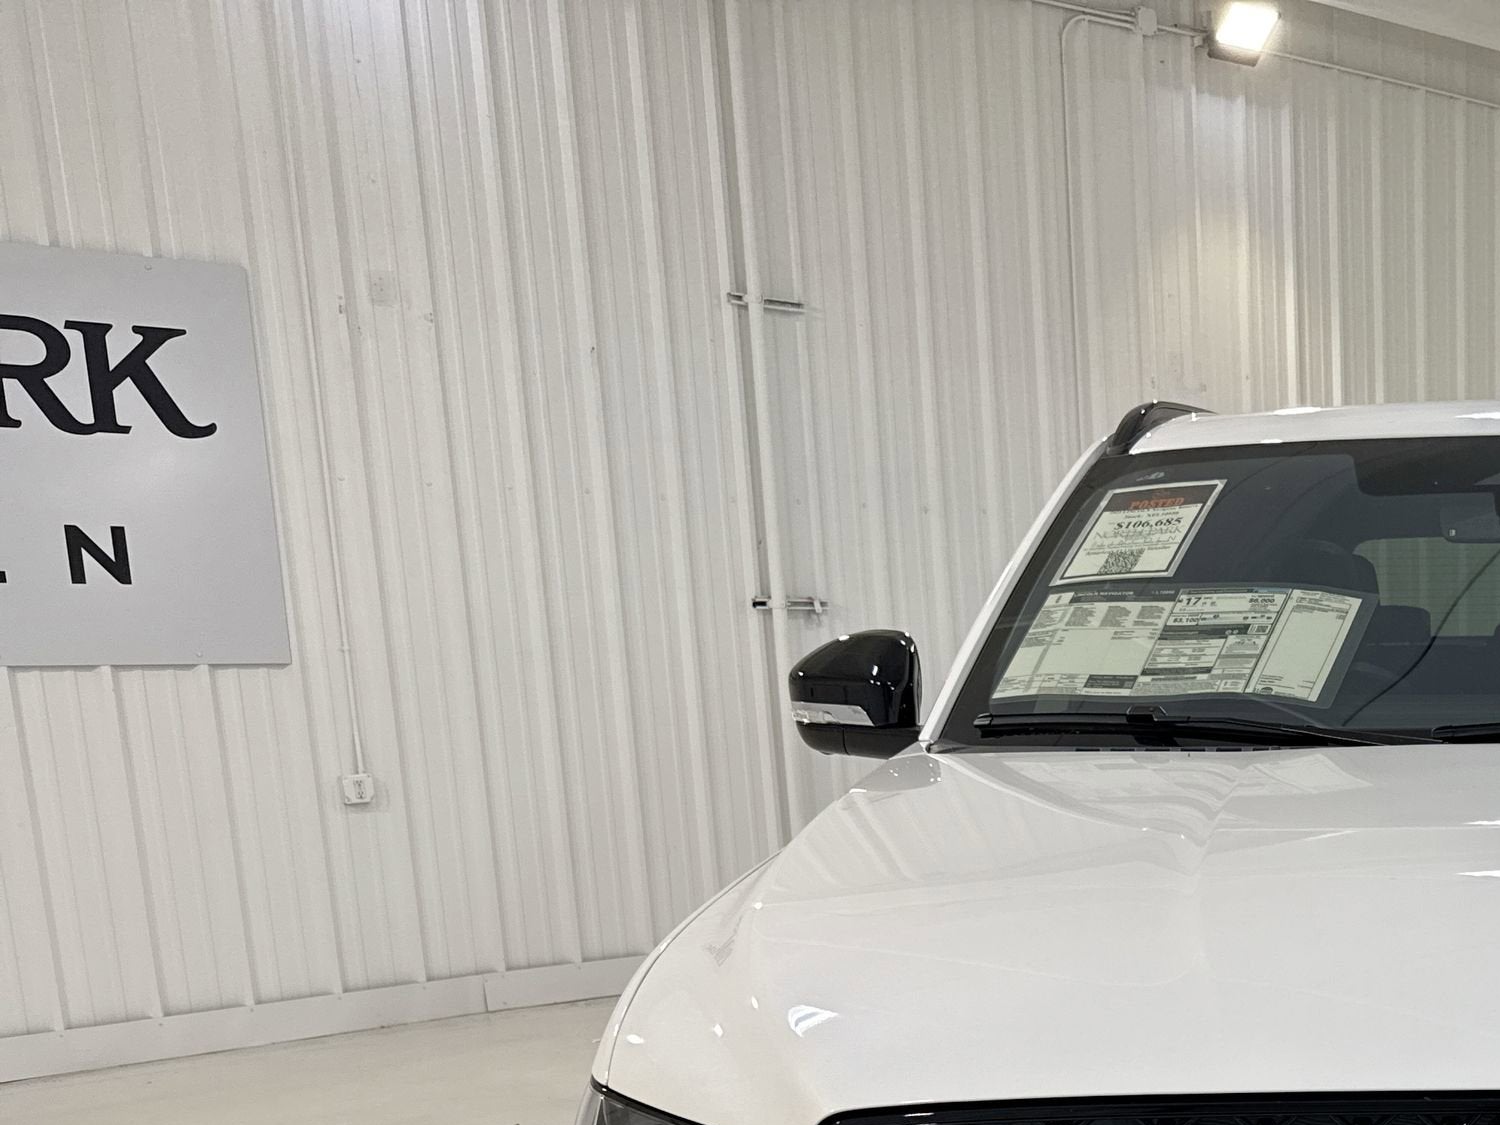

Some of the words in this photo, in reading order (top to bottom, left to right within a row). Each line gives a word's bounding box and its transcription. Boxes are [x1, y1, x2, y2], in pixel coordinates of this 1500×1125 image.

[1129, 497, 1185, 510] POSTED
[1113, 516, 1184, 531] $106,685
[1185, 596, 1202, 606] 17
